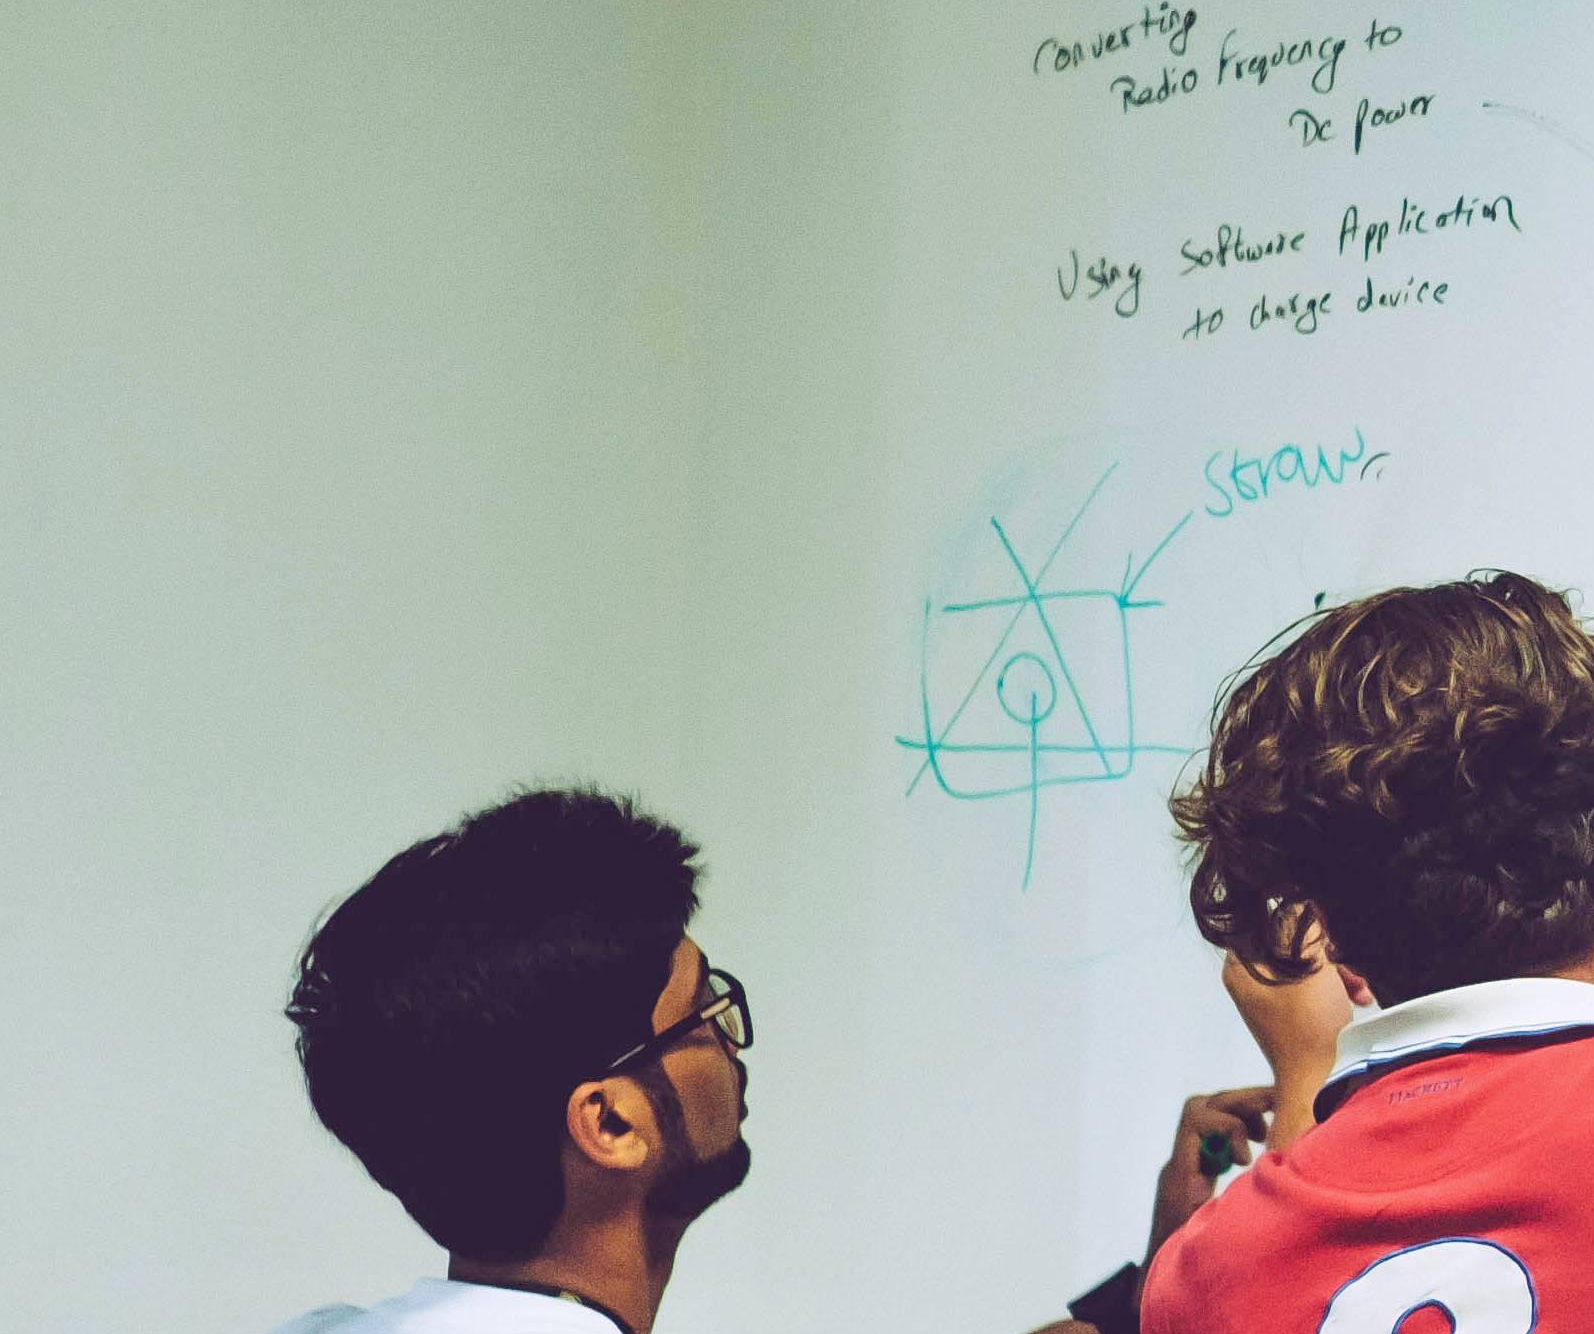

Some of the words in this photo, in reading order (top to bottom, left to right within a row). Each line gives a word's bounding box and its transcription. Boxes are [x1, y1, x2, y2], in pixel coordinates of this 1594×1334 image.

[1033, 0, 1197, 76] Converting
[1110, 68, 1198, 114] Radio
[1364, 19, 1403, 46] to
[1057, 249, 1142, 319] Using
[1337, 193, 1522, 262] Application
[1181, 306, 1224, 340] to
[1248, 284, 1333, 335] charge
[1356, 273, 1450, 313] device
